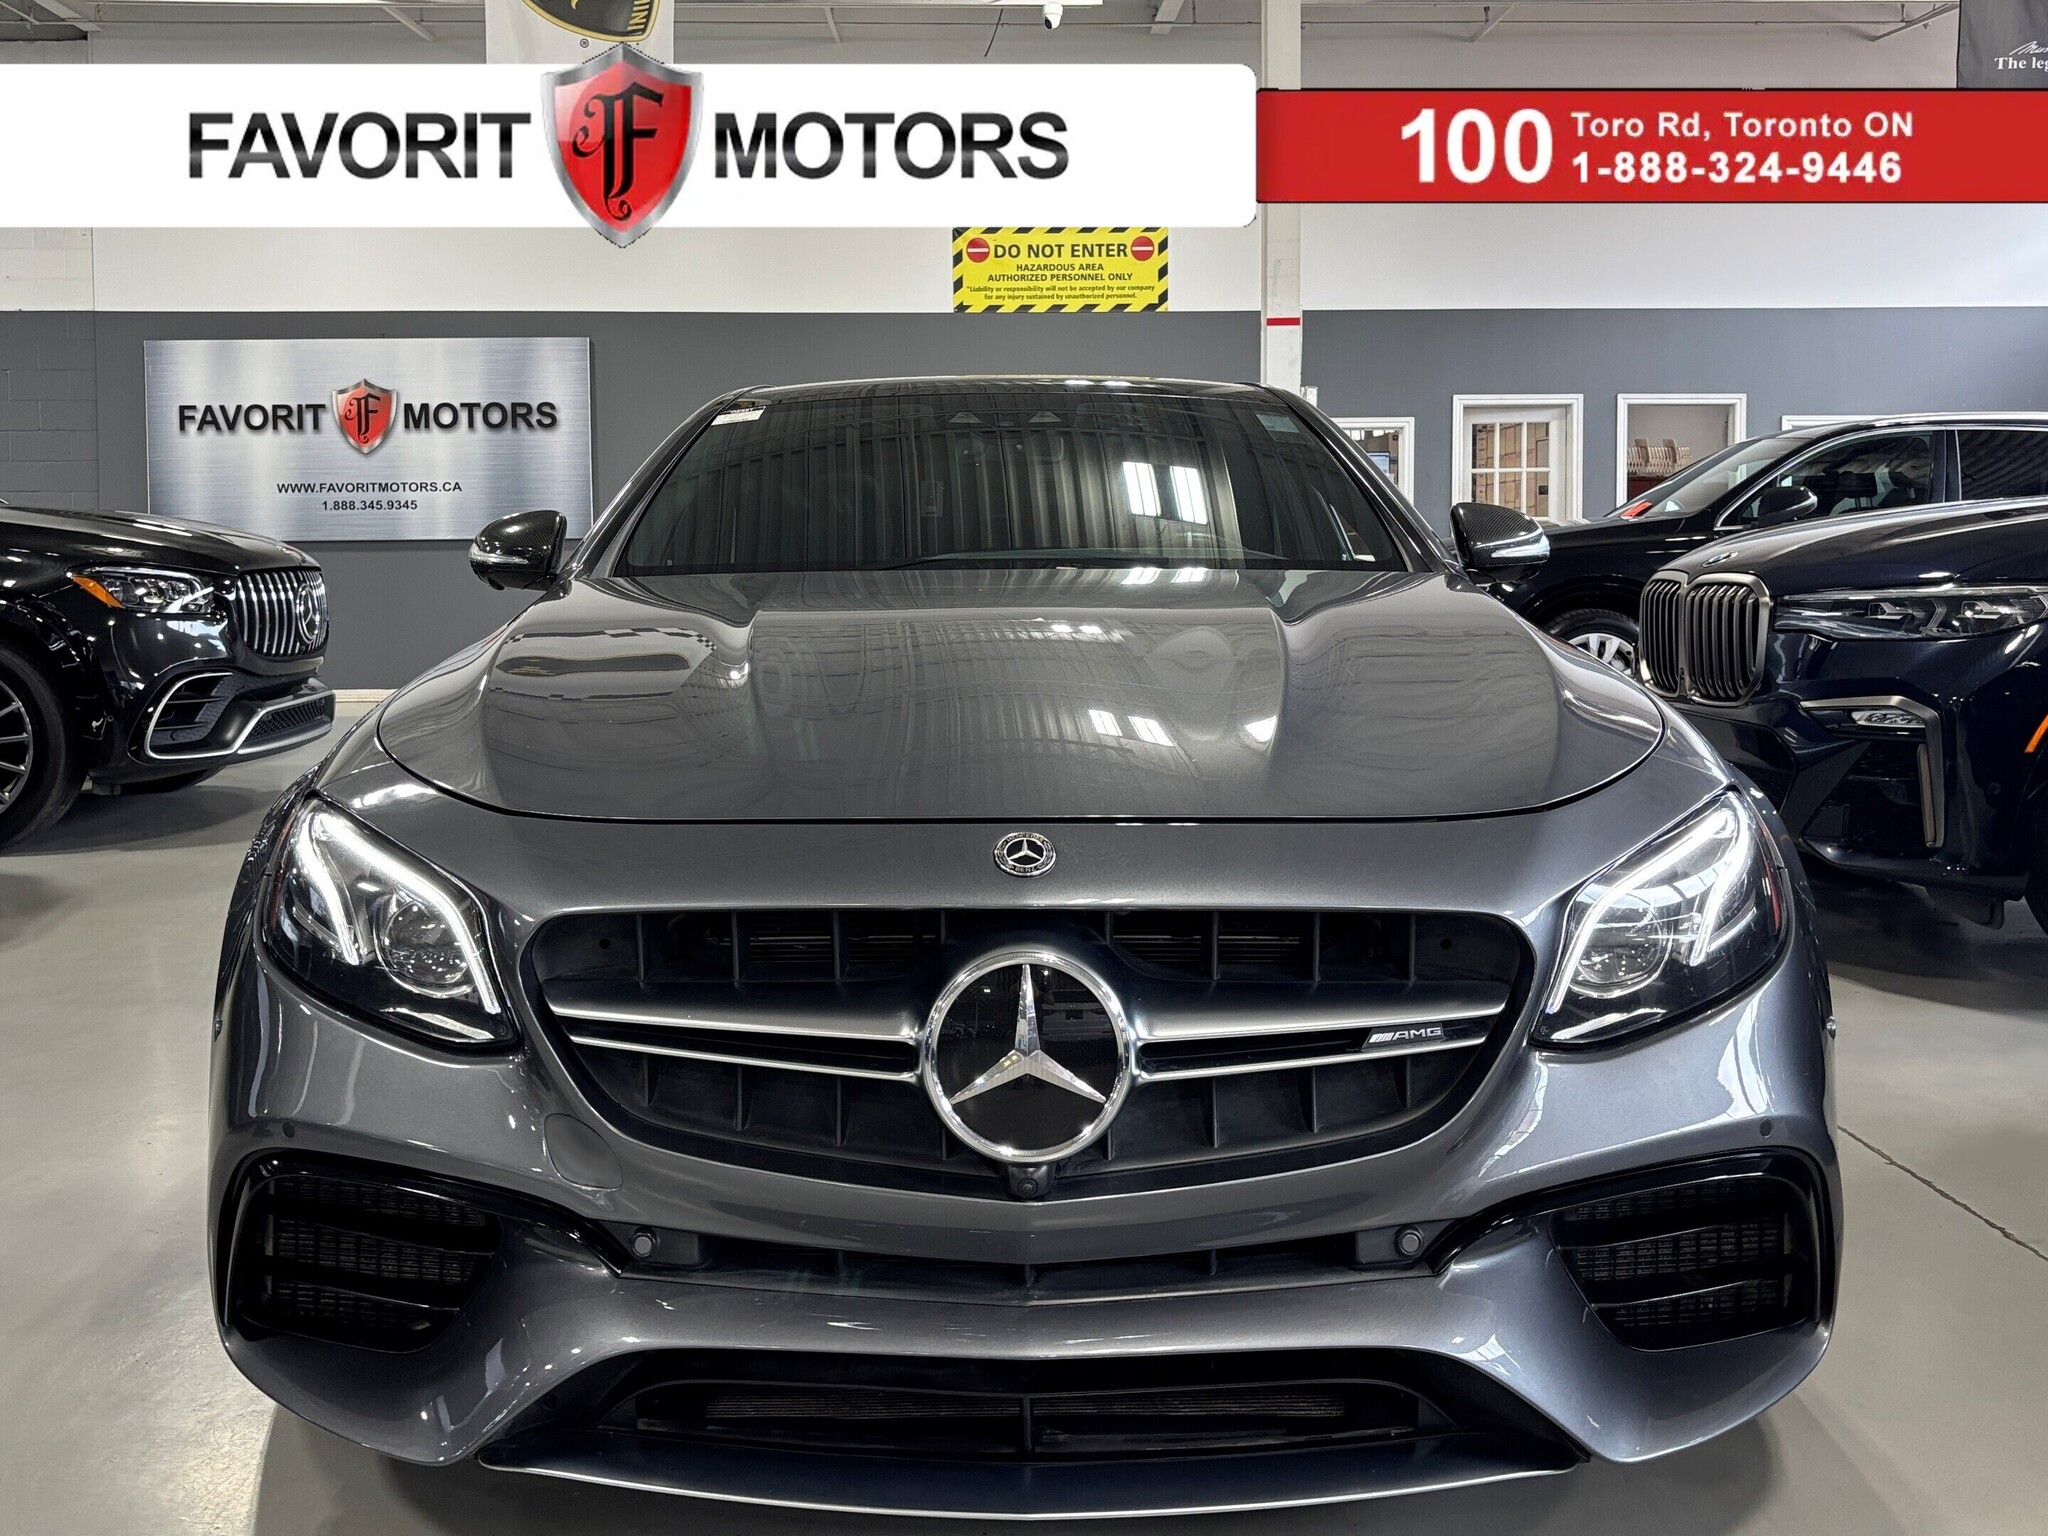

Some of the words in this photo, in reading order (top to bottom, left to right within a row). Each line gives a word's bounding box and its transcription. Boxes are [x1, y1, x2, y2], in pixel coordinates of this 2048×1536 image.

[1994, 57, 2027, 71] The
[993, 243, 1021, 259] DO
[1027, 243, 1065, 259] NOT
[1070, 243, 1128, 258] ENTER
[1016, 263, 1076, 272] HAZARDOUS
[1078, 263, 1104, 272] AREA
[987, 273, 1048, 282] AUTHORIZED
[1050, 273, 1106, 282] PERSONNEL
[1108, 272, 1133, 281] ONLY
[1003, 285, 1044, 293] responsibility
[1078, 285, 1106, 293] accepted
[1105, 292, 1138, 300] personnel.
[178, 403, 326, 432] FAVORIT
[403, 401, 558, 430] MOTORS
[276, 481, 463, 494] WWW.FAVORITMOTORS.CA
[321, 499, 419, 511] 1.888.345.9345
